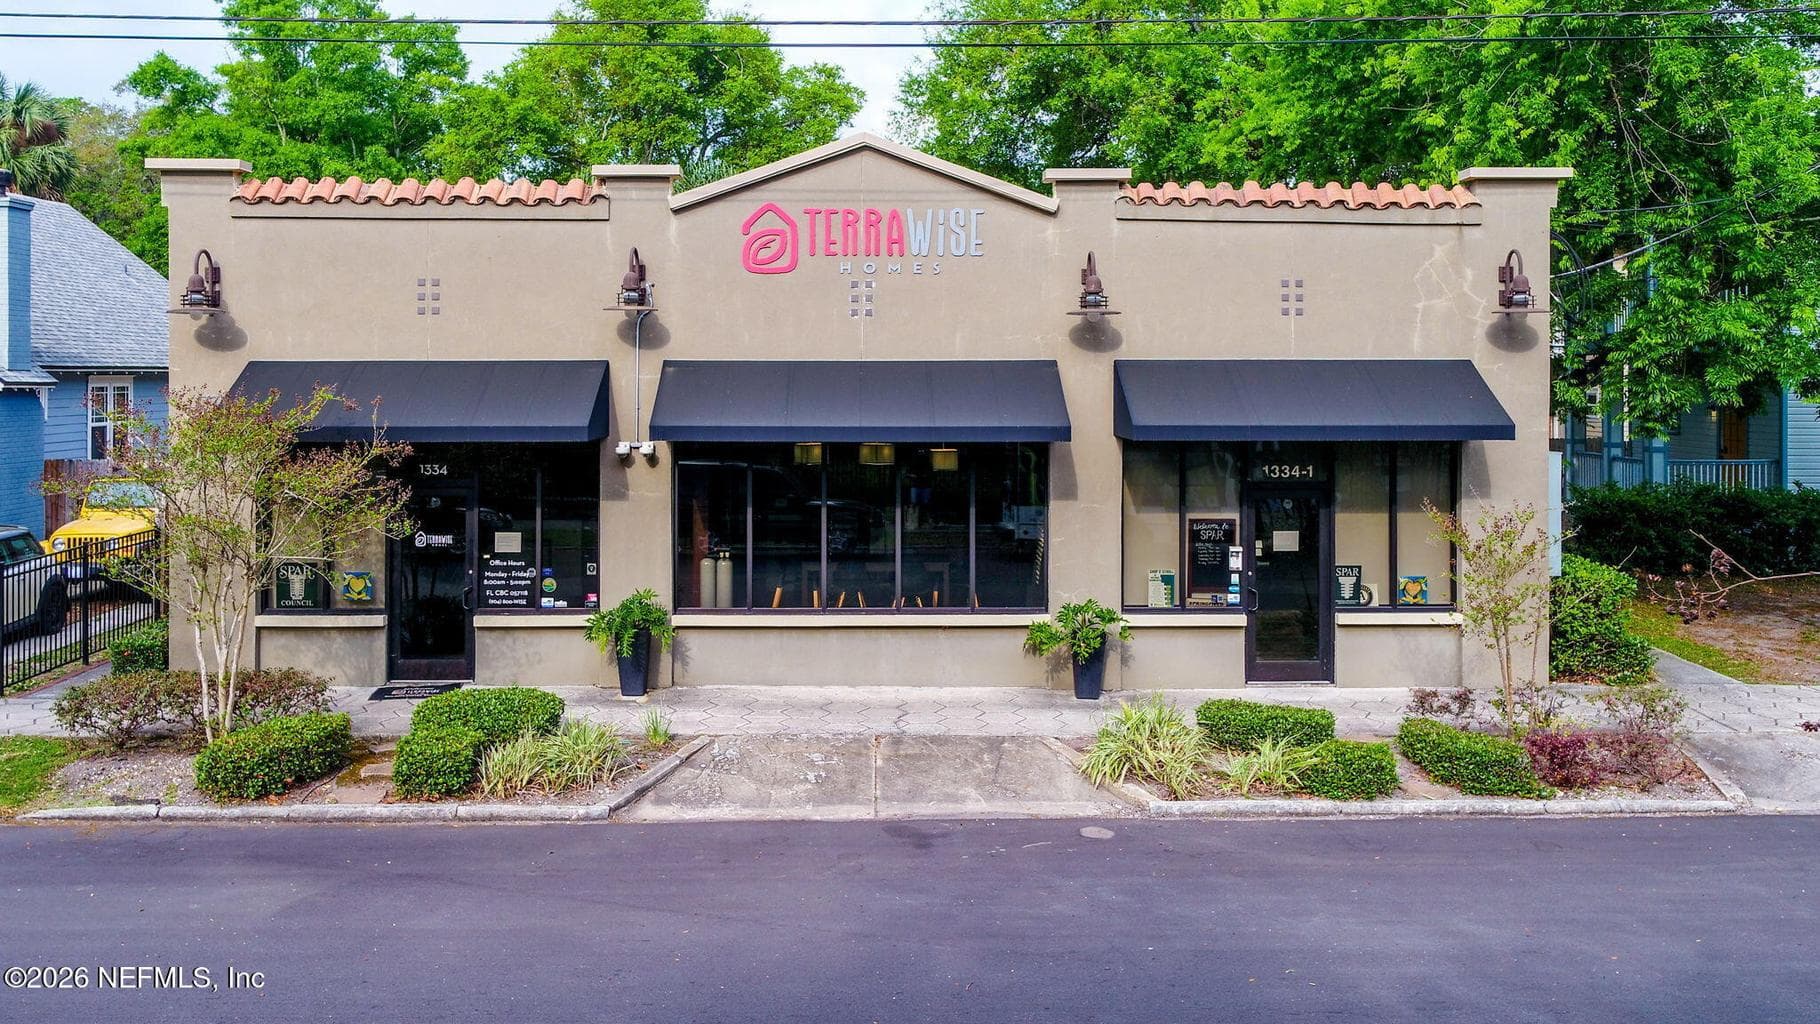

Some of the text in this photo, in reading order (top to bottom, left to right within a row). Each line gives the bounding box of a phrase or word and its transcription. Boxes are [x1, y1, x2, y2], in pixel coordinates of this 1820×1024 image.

[840, 262, 942, 275] HOMES
[419, 464, 448, 475] 1334
[1262, 464, 1313, 478] 1334-1
[1199, 530, 1225, 540] SPAR
[484, 570, 508, 578] Monday
[511, 570, 530, 578] Friday
[1335, 567, 1360, 577] SPAR
